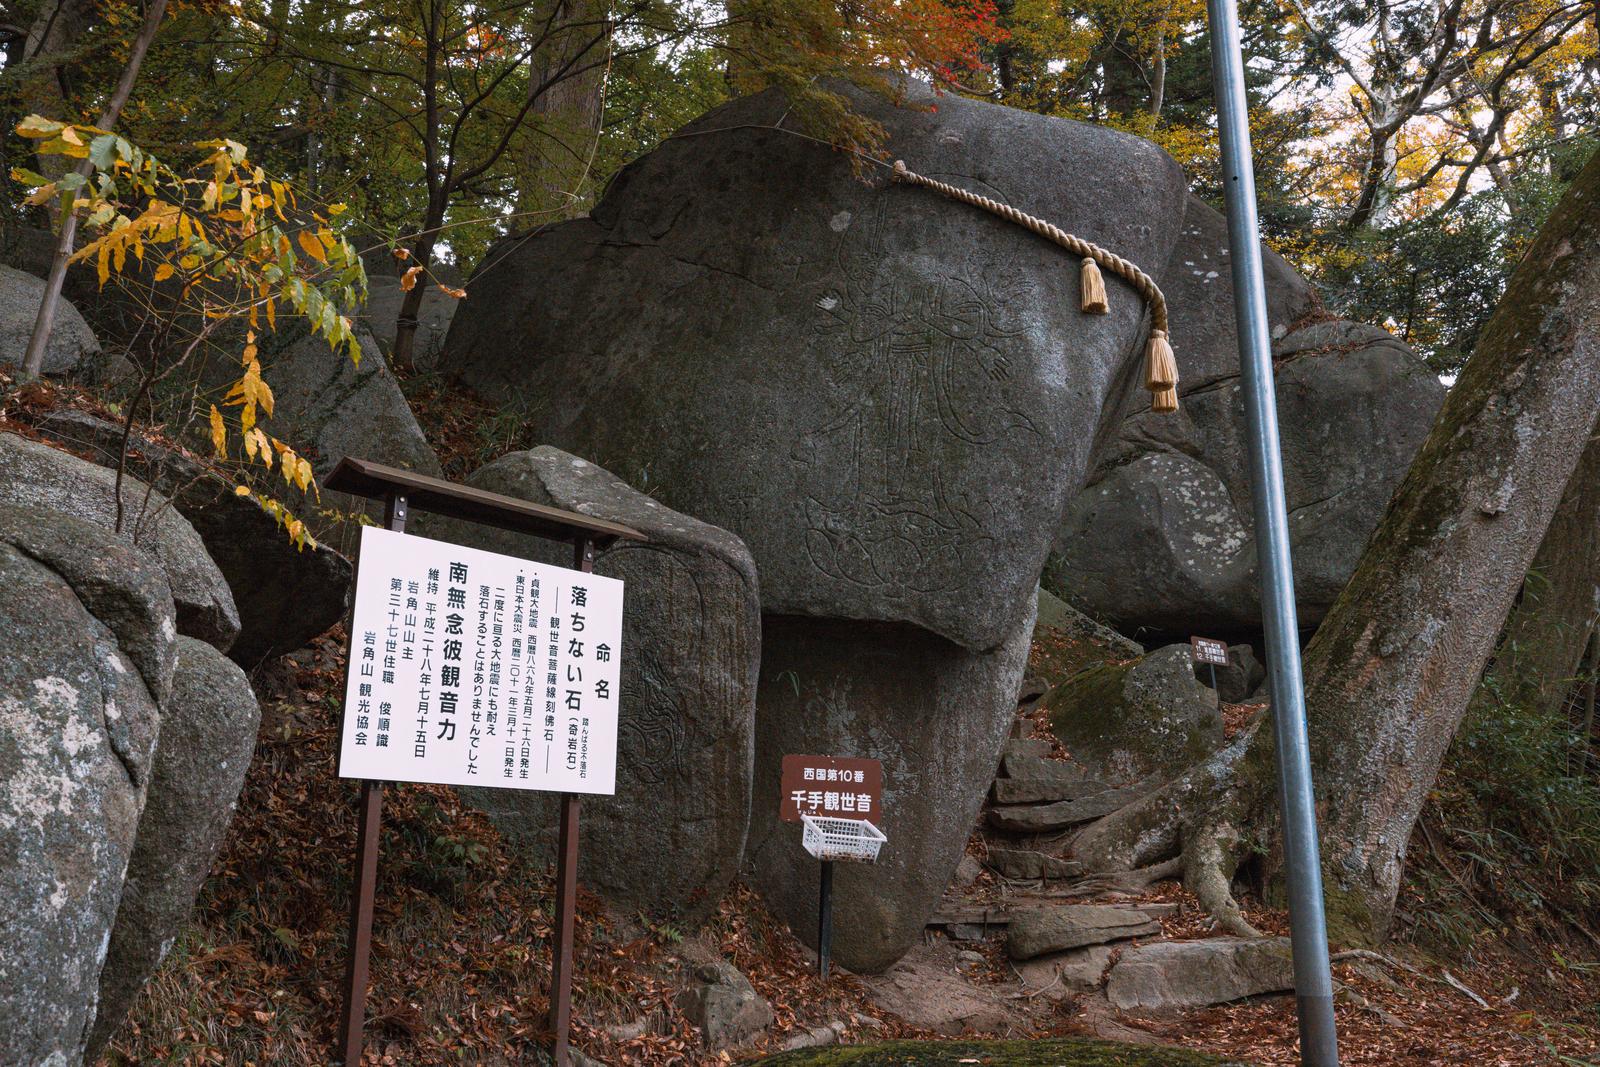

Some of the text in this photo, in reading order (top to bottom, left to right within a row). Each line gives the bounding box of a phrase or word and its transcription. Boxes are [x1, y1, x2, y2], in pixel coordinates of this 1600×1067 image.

[402, 581, 418, 660] 岩角山山主
[437, 562, 468, 740] 南無念彼観音力
[468, 586, 490, 774] 落石することはありませんでした
[595, 643, 610, 699] 命名
[791, 790, 872, 812] 千手観世音
[804, 768, 864, 783] 西国第10番
